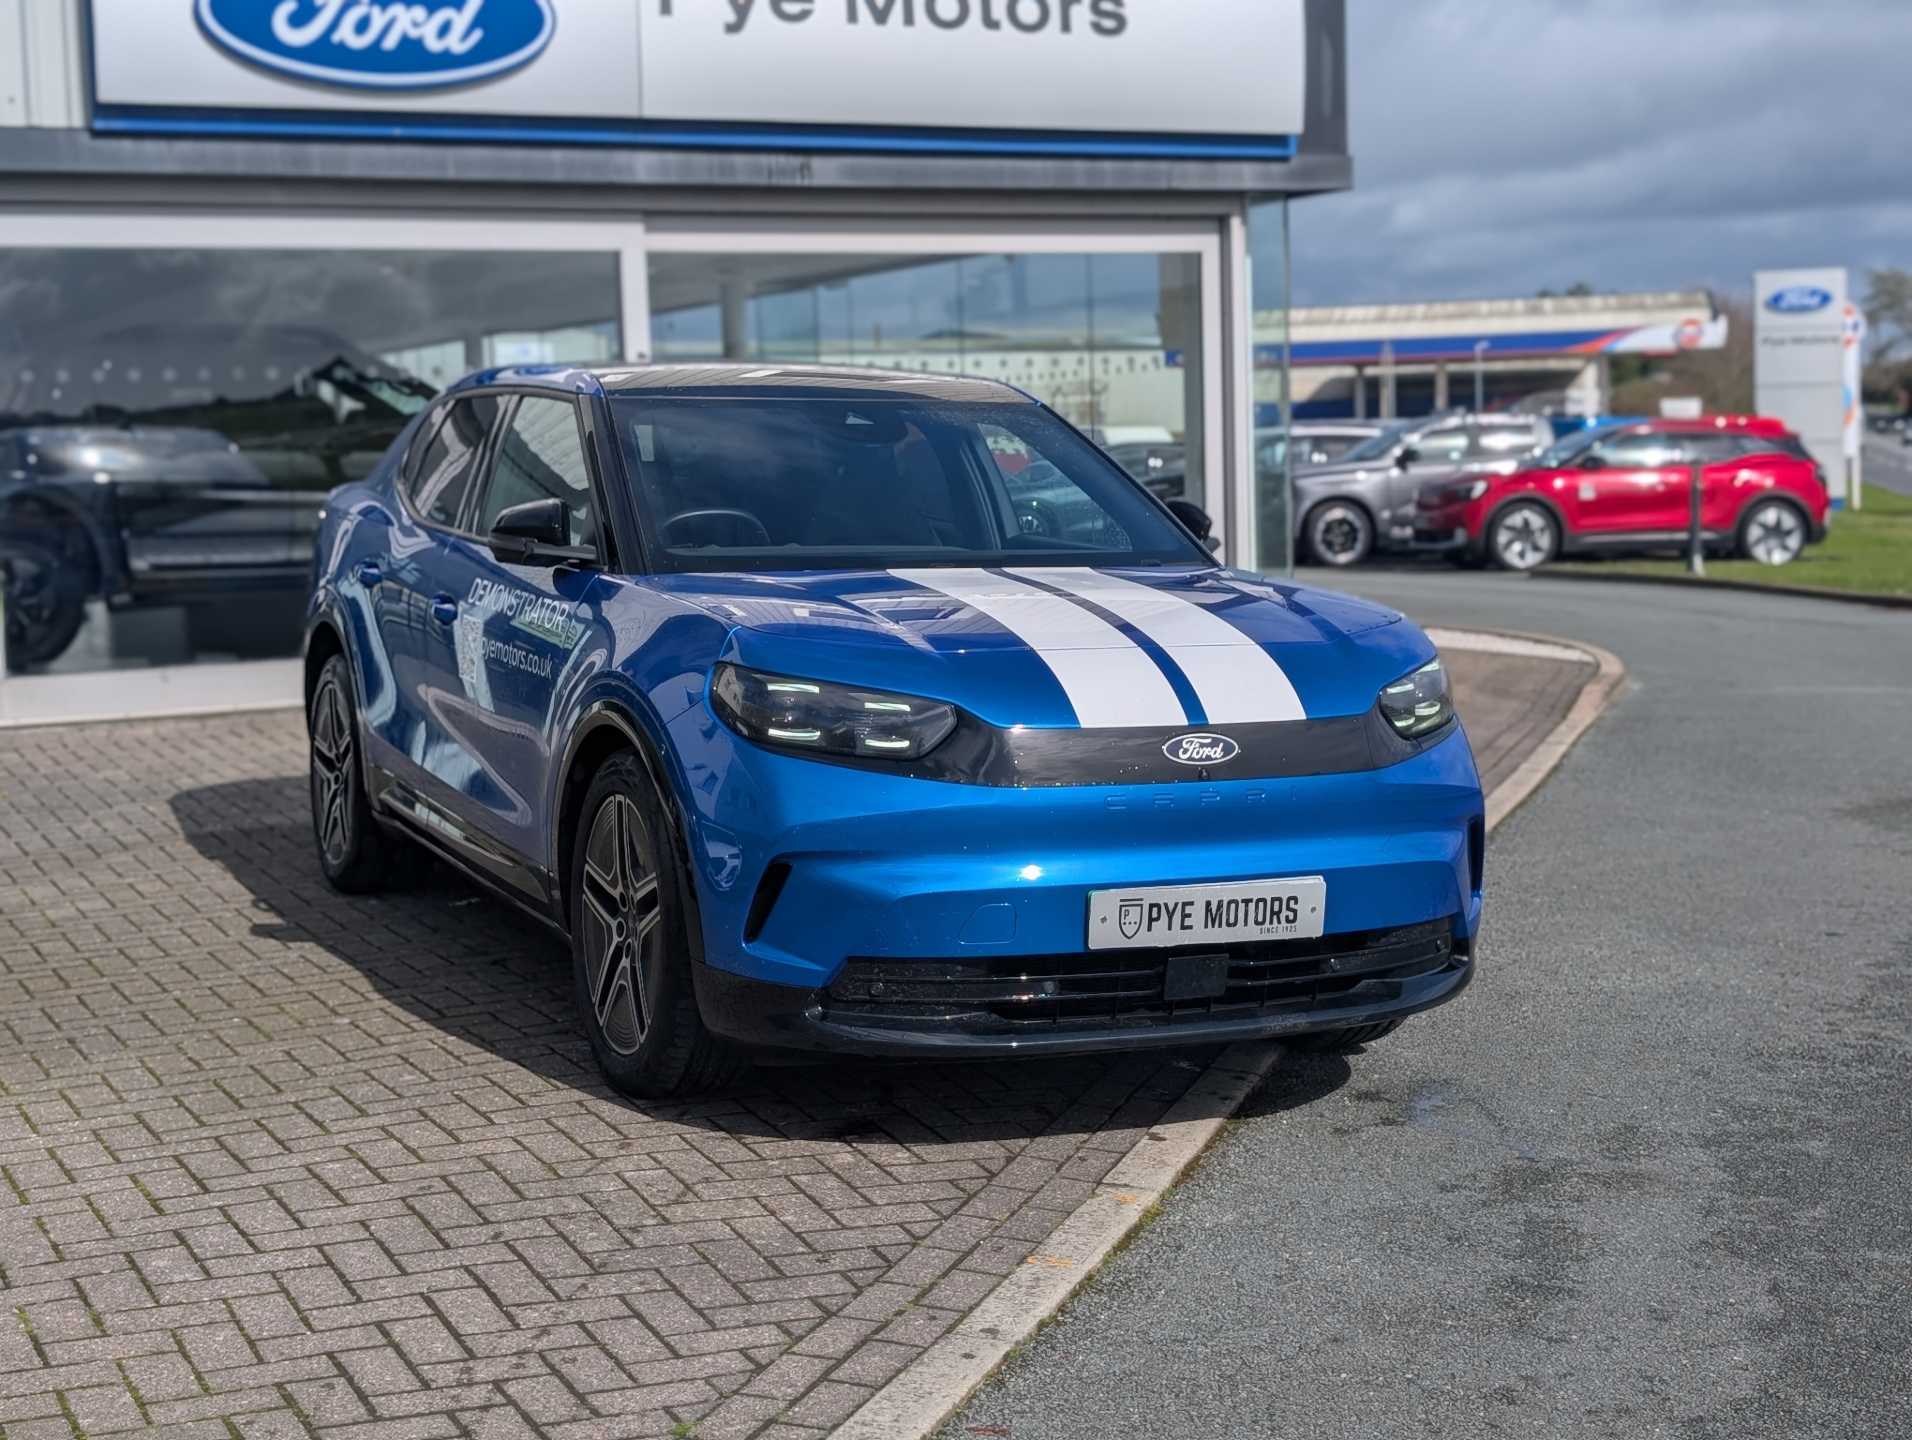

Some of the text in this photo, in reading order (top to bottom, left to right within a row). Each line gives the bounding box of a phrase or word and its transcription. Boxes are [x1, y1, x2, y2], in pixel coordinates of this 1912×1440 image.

[659, 0, 815, 34] ye
[468, 578, 569, 632] DEMONSTRATOR
[480, 637, 552, 679] pyemotors.co.uk
[1178, 737, 1224, 759] Ford
[1147, 896, 1299, 932] PYE MOTORS
